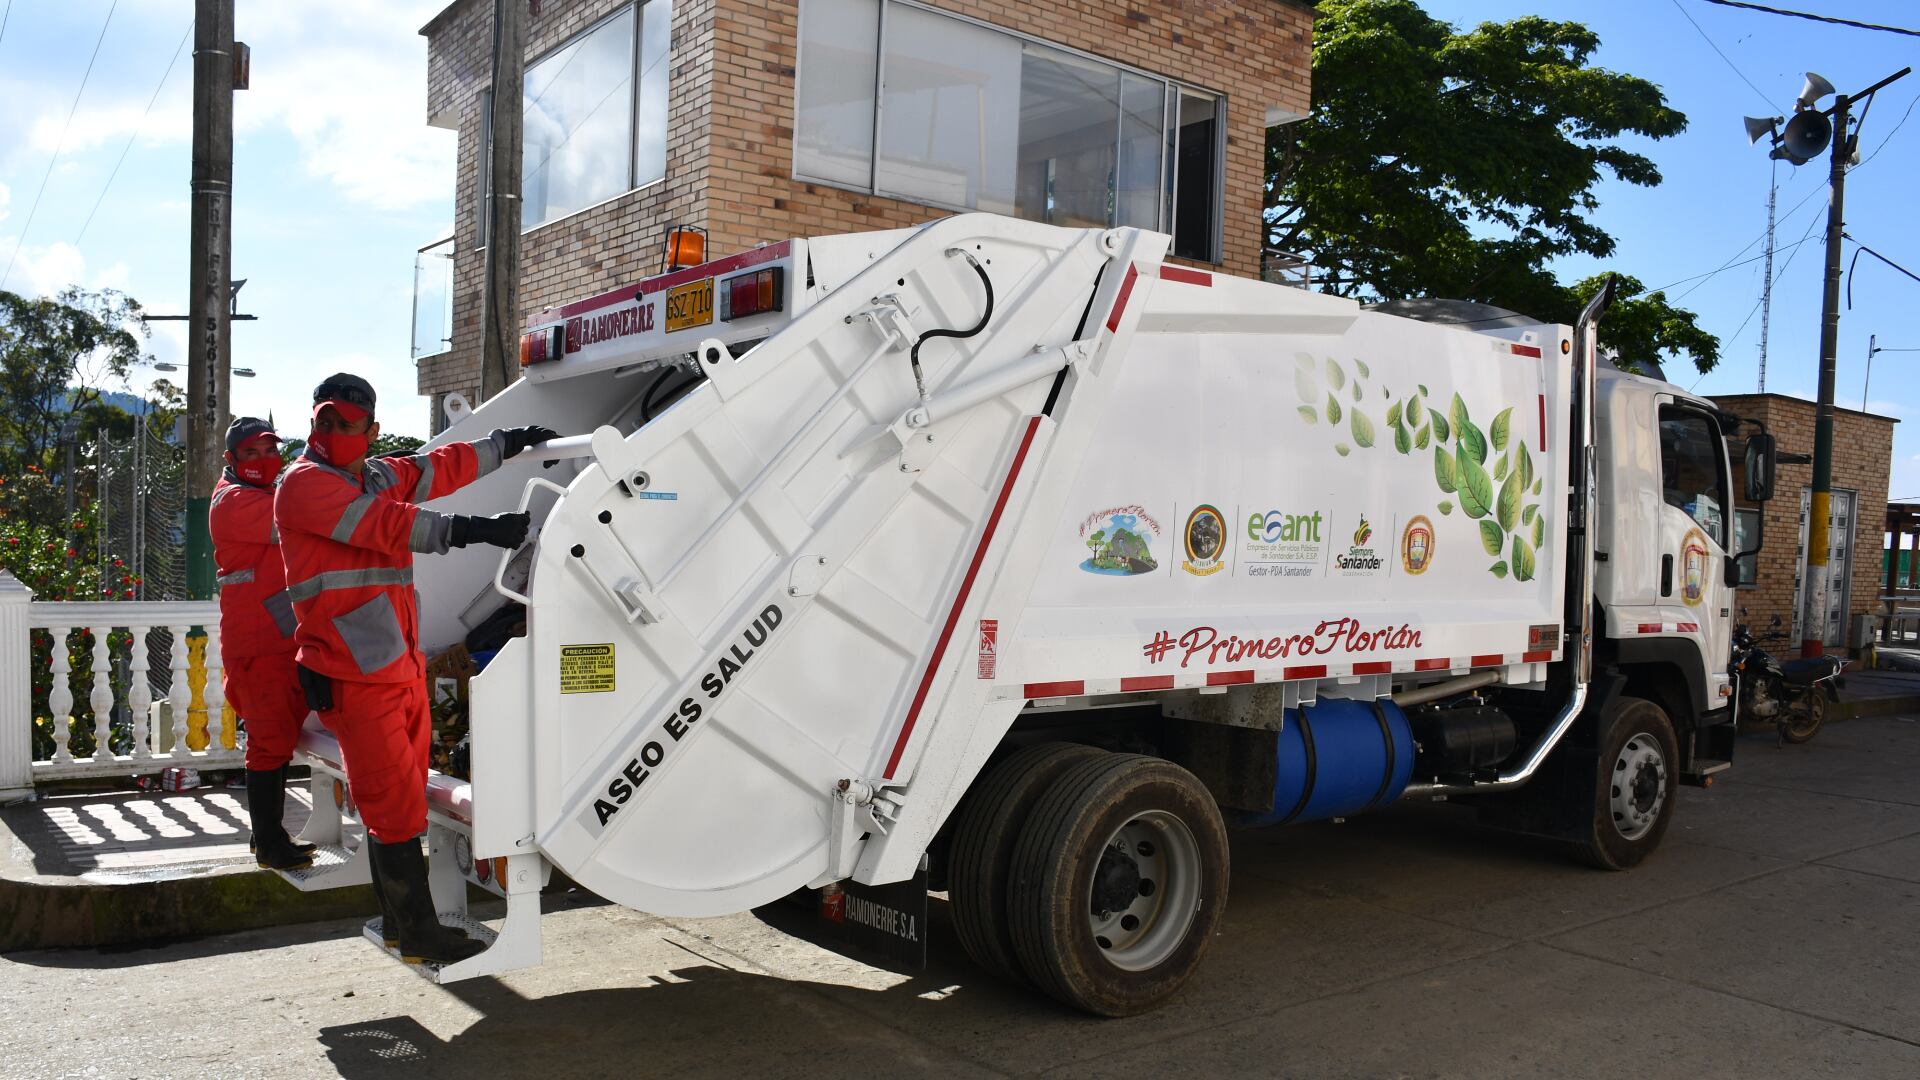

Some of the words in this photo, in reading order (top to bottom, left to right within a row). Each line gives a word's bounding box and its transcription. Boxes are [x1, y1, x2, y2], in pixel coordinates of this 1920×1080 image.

[666, 292, 687, 320] GSZ
[691, 287, 712, 315] 710
[582, 302, 655, 346] RAMONERRE
[1335, 554, 1381, 570] Santander
[1349, 546, 1374, 558] Siempre
[1284, 566, 1312, 577] Santander
[593, 741, 665, 827] ASEO
[663, 697, 703, 742] ES
[700, 604, 783, 699] SALUD
[845, 894, 899, 935] RAMONERRE
[900, 912, 918, 942] S.A.
